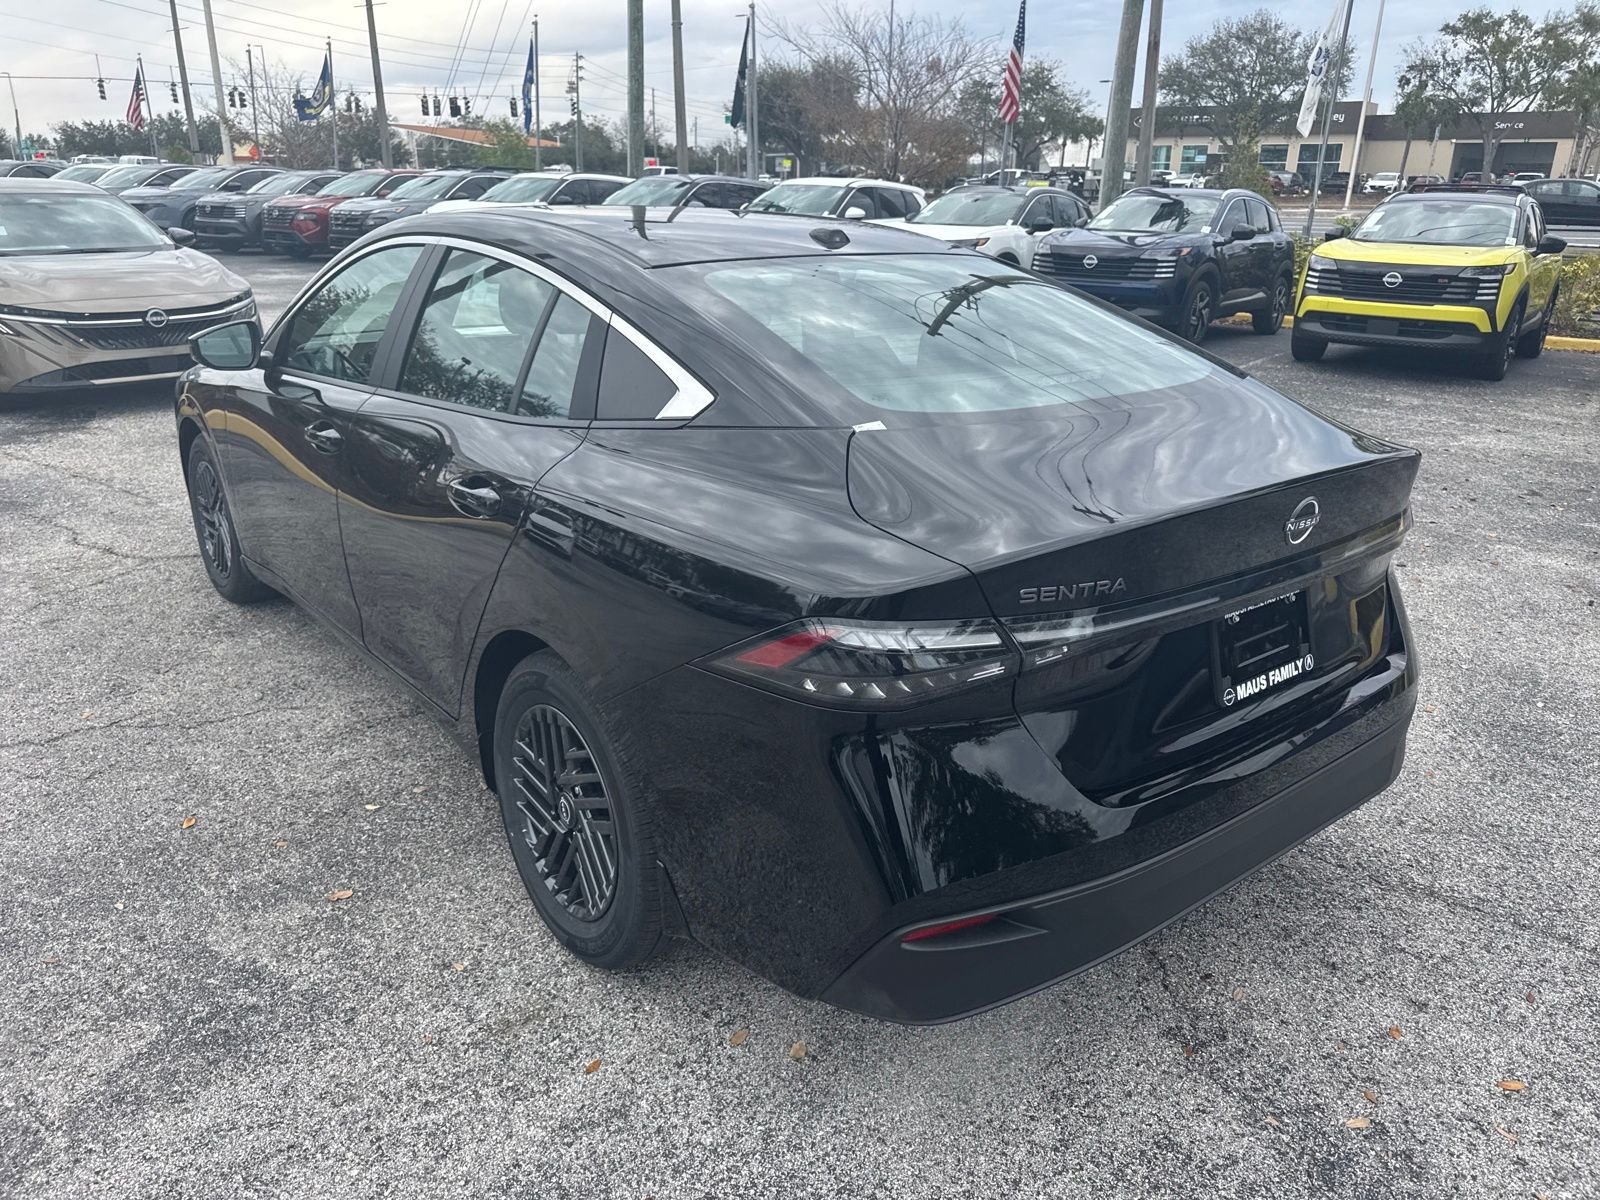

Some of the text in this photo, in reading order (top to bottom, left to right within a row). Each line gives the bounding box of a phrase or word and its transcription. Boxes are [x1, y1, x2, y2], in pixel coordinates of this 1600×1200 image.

[1494, 121, 1524, 129] Servce
[1019, 578, 1127, 604] SENTRA
[1236, 658, 1304, 701] MAUS FAMILY
